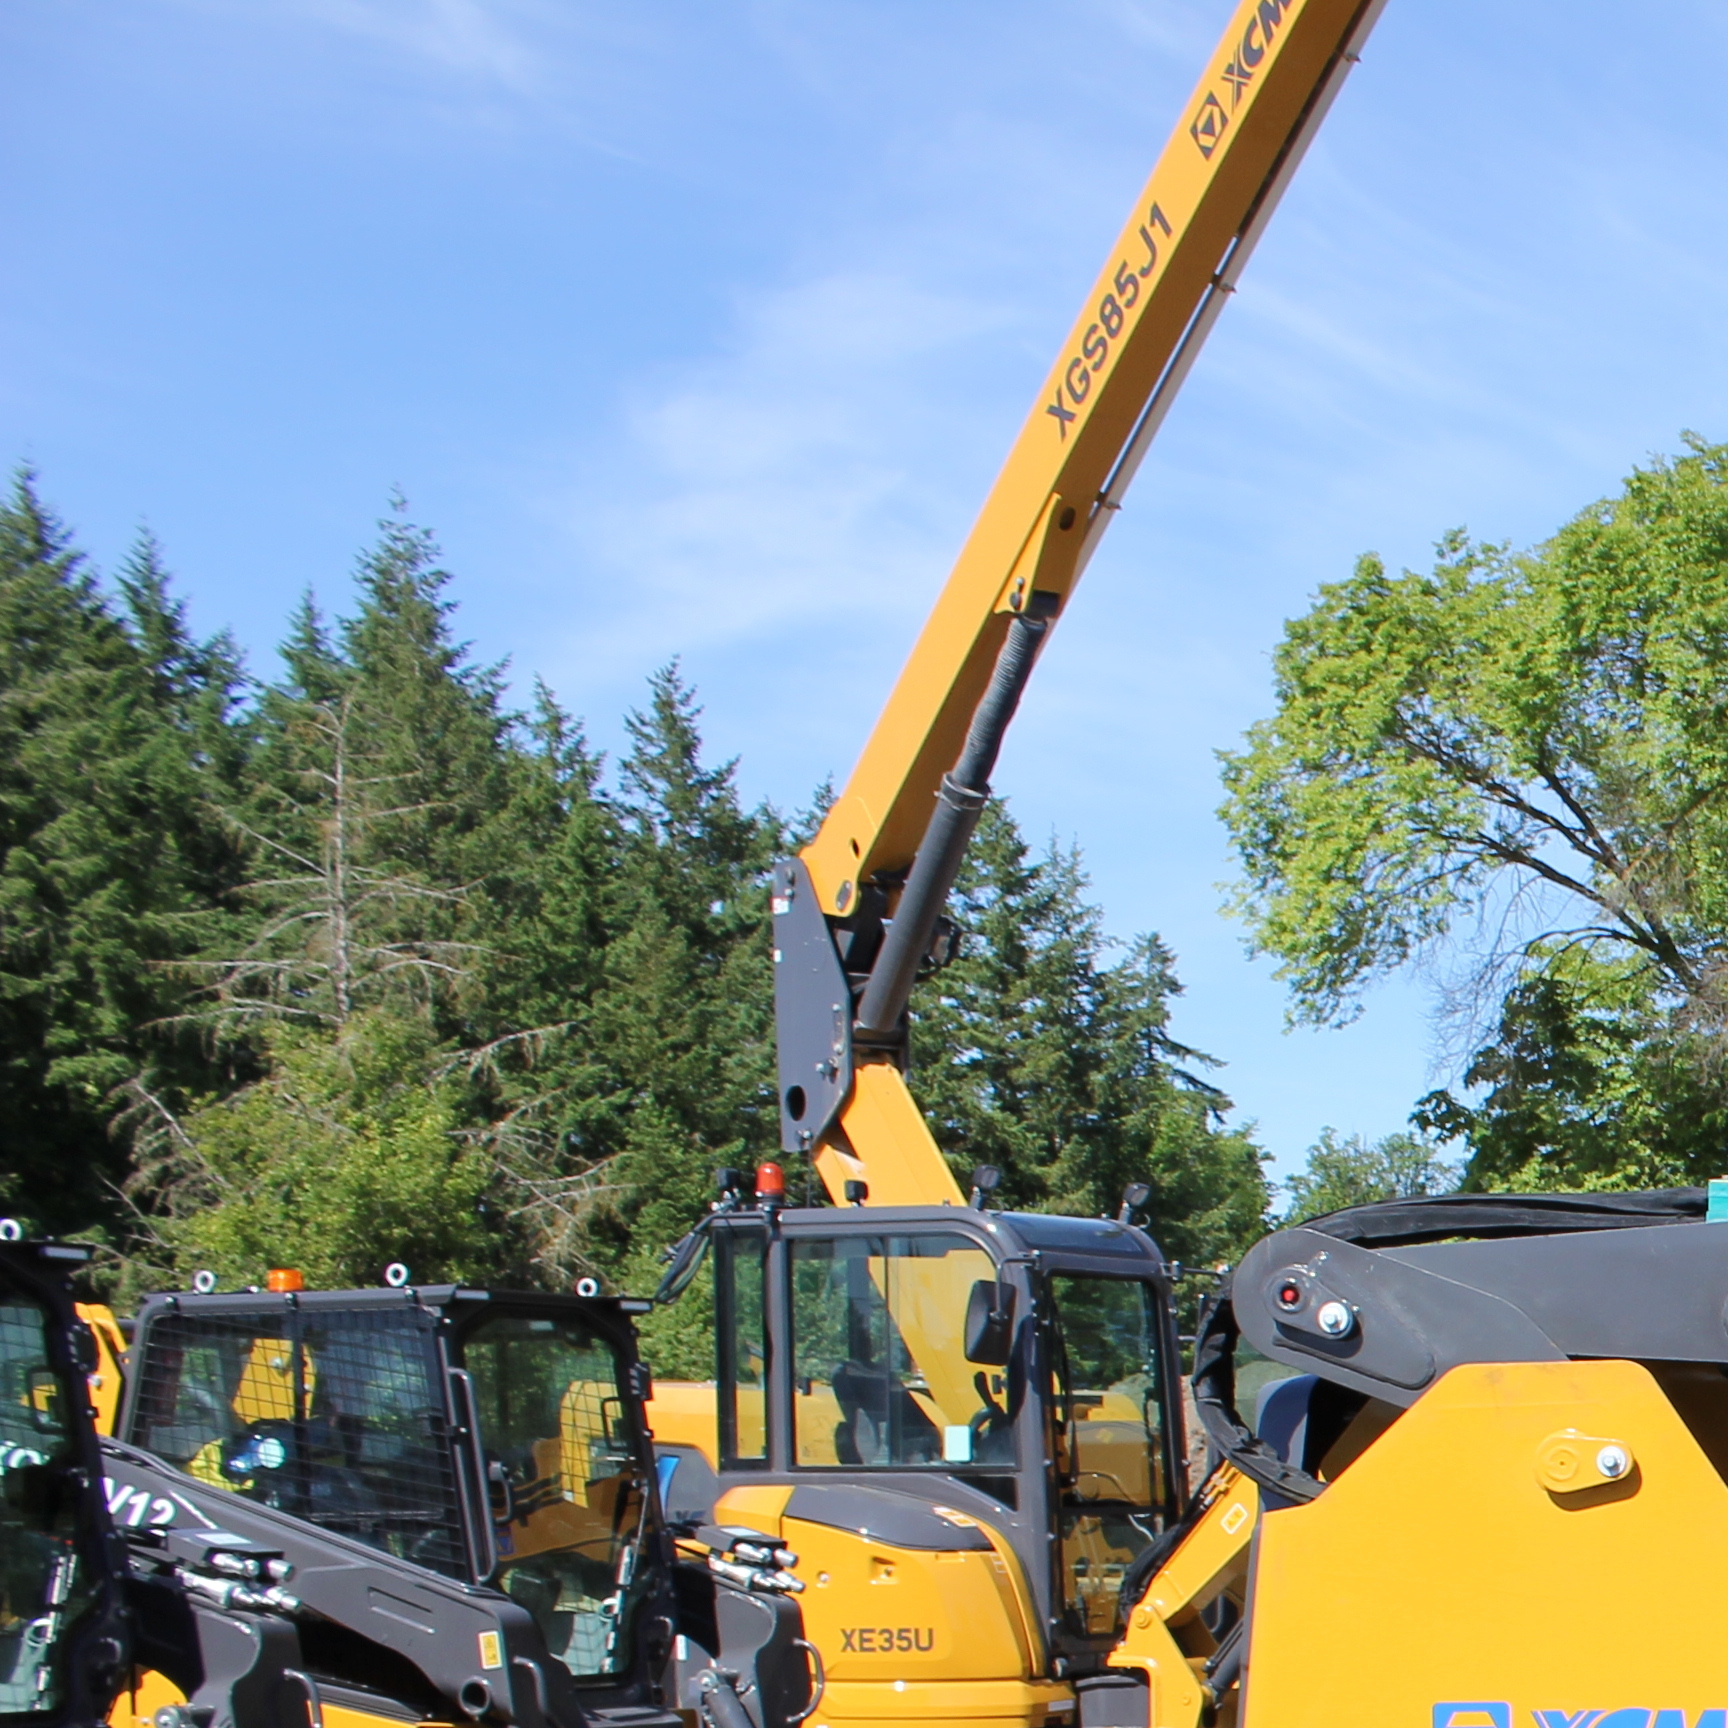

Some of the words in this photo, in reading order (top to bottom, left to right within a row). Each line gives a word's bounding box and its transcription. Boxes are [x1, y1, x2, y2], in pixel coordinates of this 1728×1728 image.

[1046, 200, 1173, 442] XGS85J1
[102, 1476, 176, 1527] V12
[840, 1627, 934, 1653] XE35U
